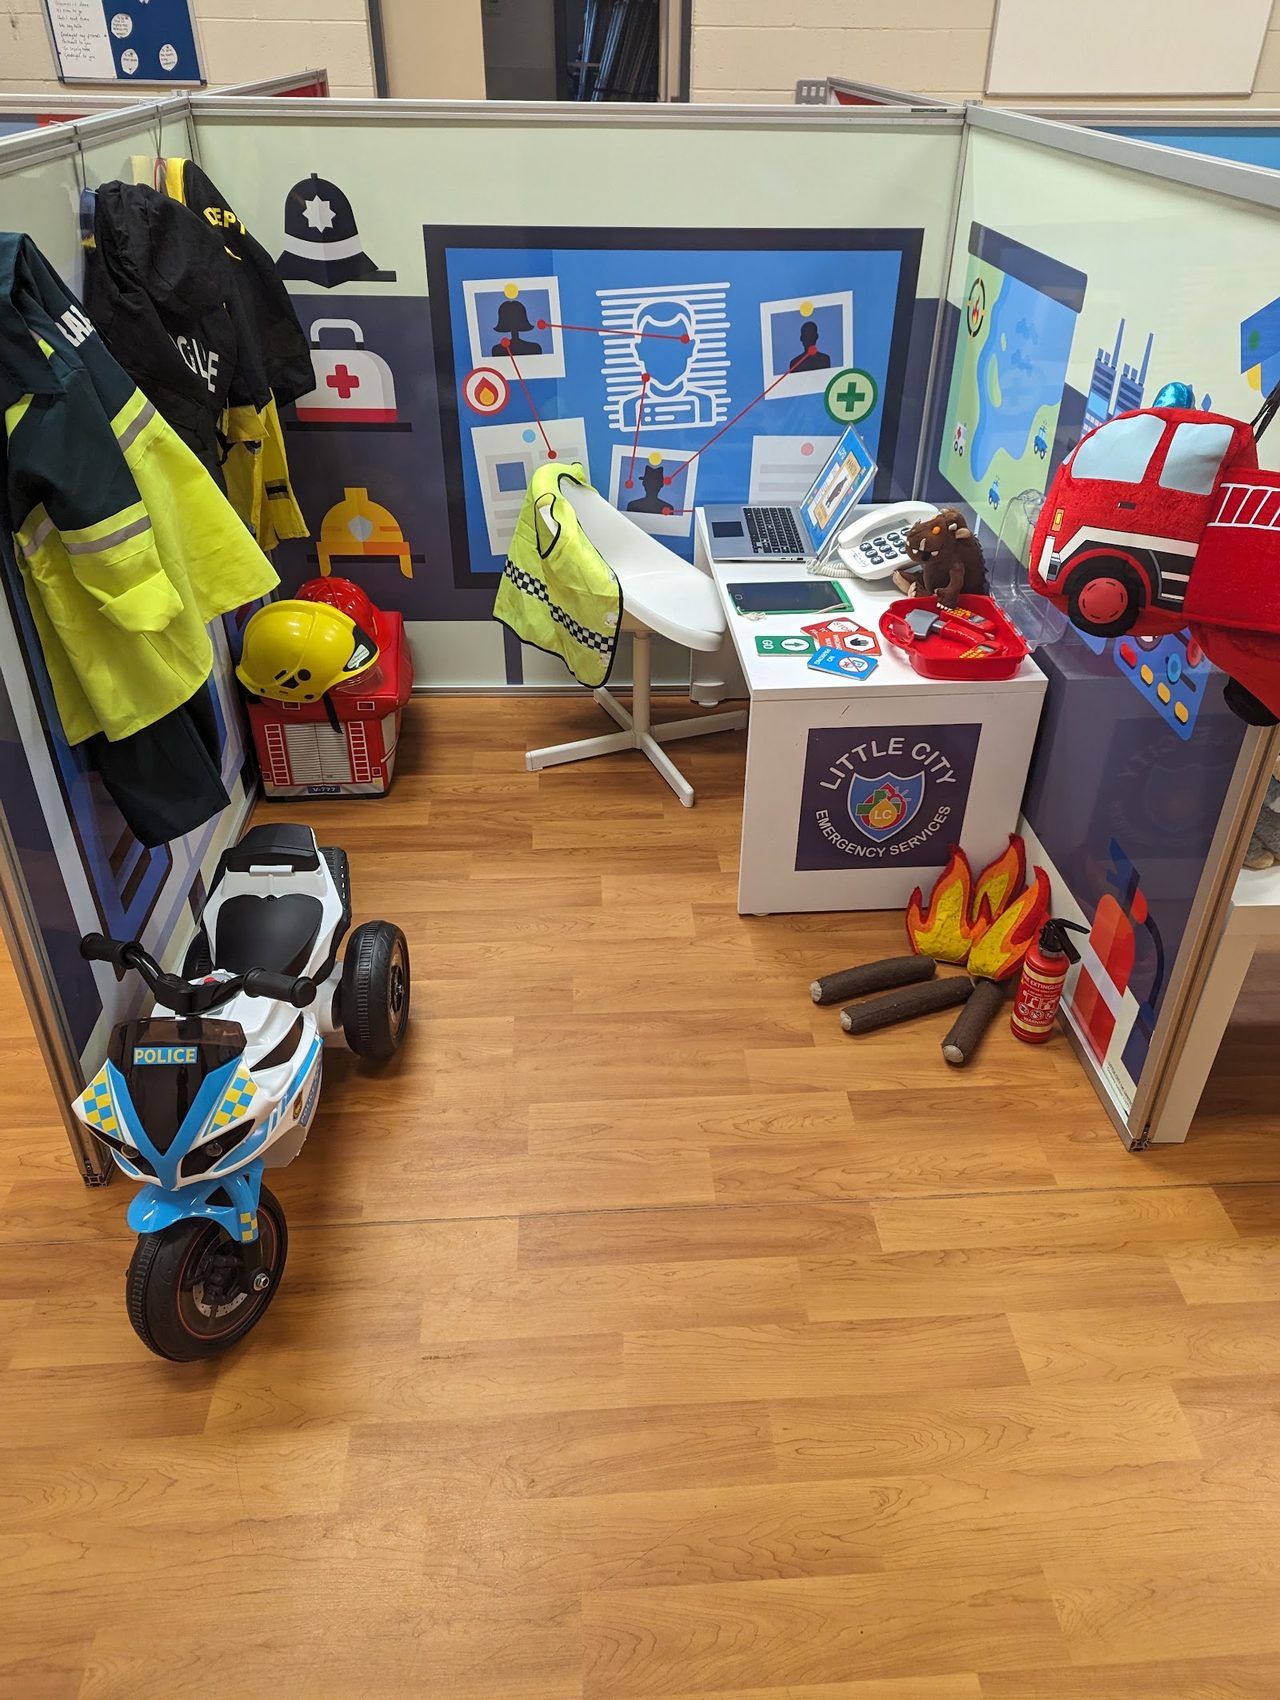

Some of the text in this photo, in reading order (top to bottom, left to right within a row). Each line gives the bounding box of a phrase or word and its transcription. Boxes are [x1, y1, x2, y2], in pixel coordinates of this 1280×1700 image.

[762, 640, 774, 650] GO
[819, 737, 957, 790] LITTLE CITY
[874, 810, 892, 820] LC
[815, 804, 952, 858] EMERGENCY SERVICES
[134, 1048, 197, 1063] POLICE
